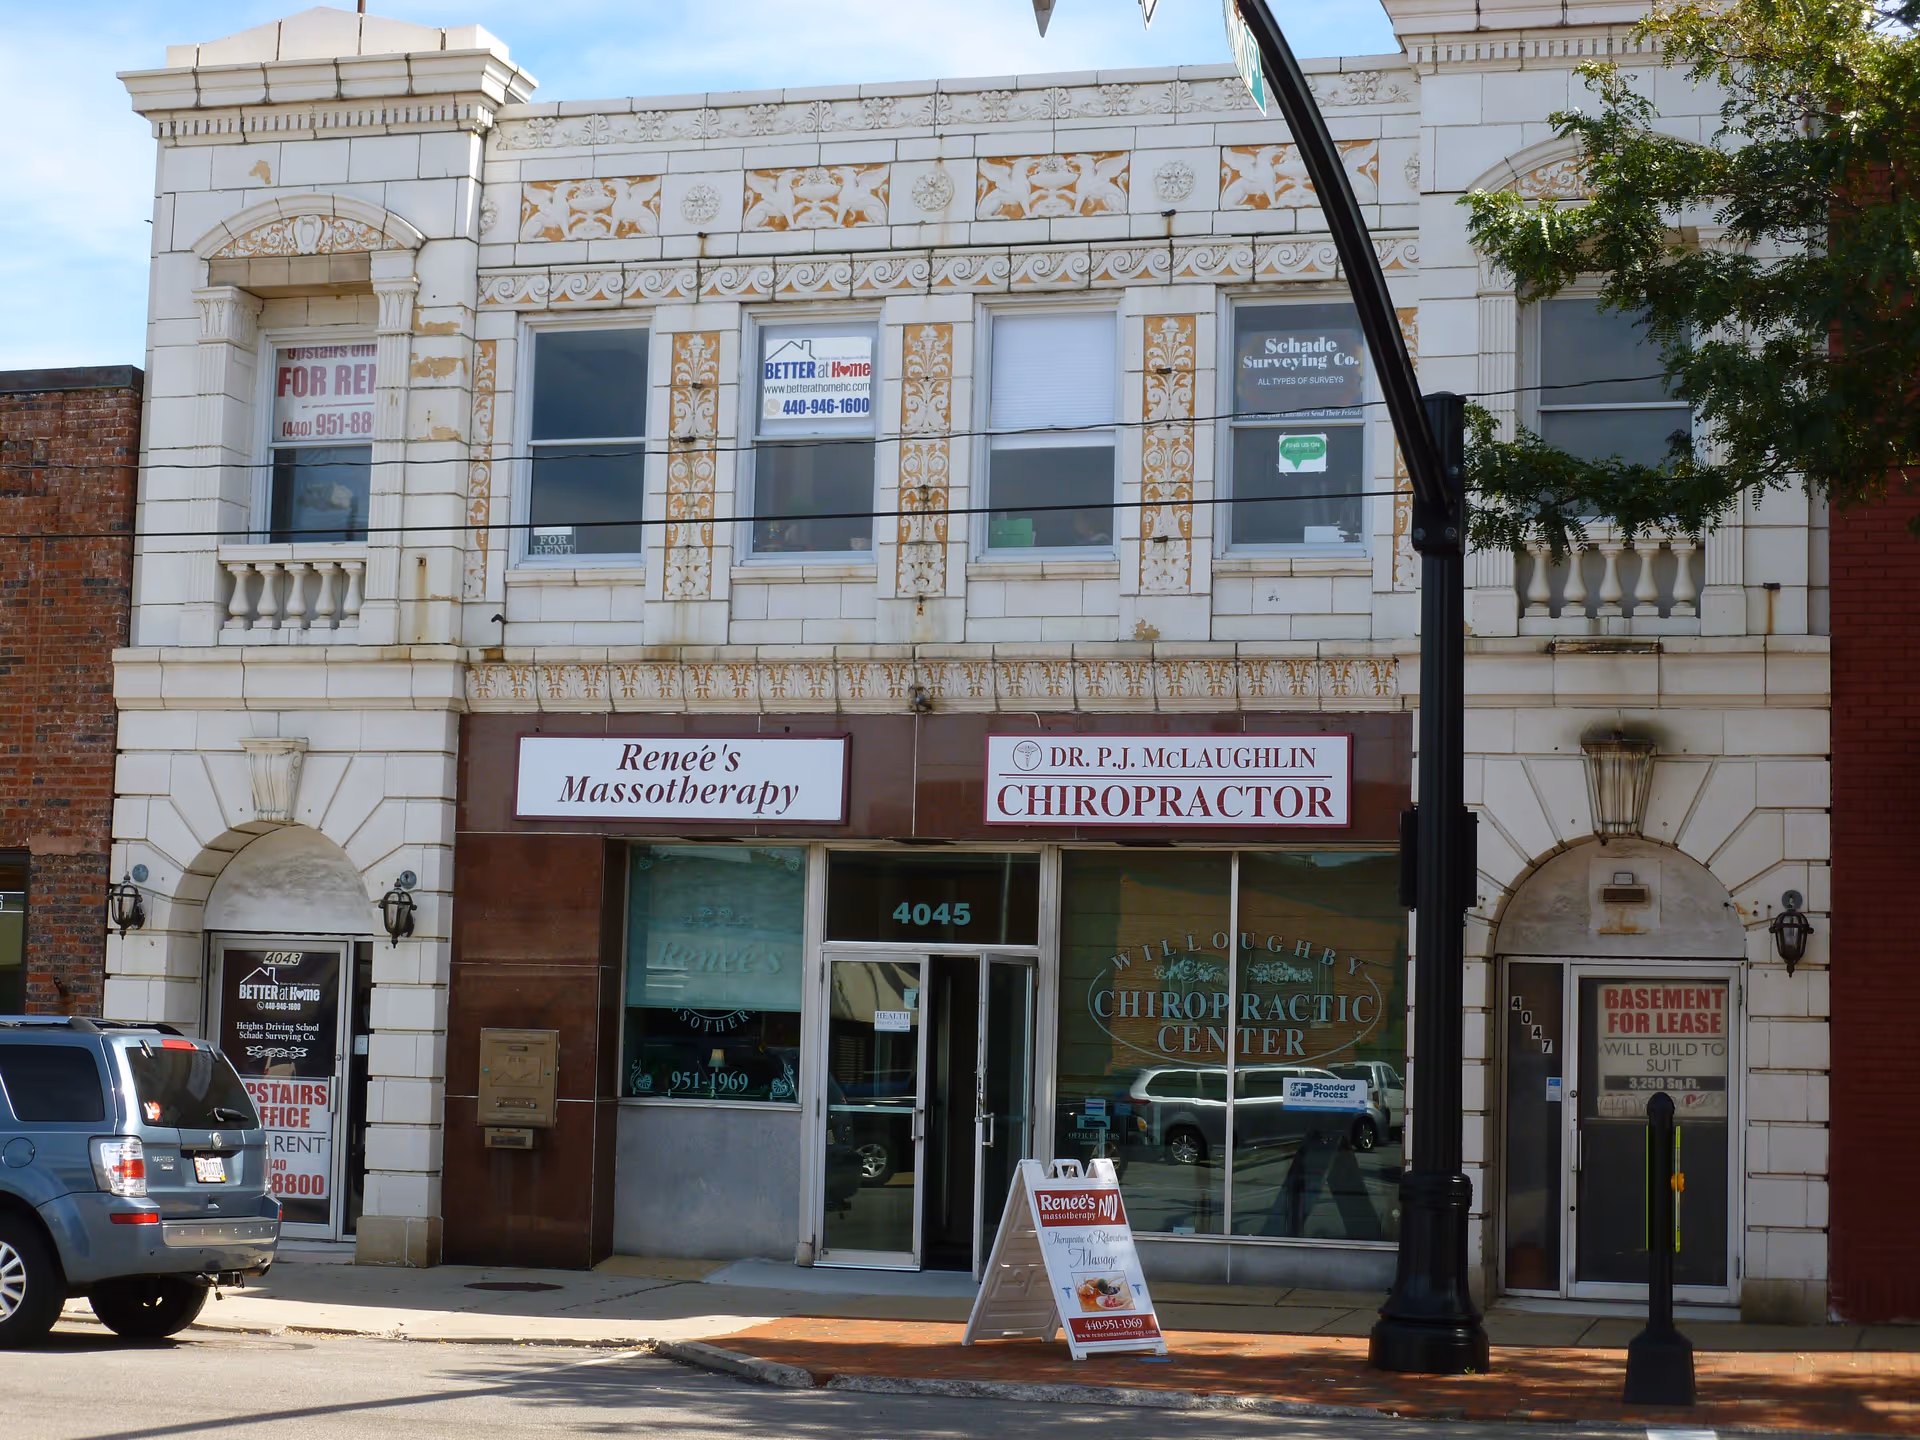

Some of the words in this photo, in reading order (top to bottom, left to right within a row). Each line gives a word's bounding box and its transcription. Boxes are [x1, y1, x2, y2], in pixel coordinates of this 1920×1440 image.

[1265, 336, 1337, 354] Schade
[765, 361, 816, 380] BETTER
[818, 361, 829, 378] at
[1243, 354, 1327, 370] Surveying
[1334, 353, 1360, 366] Co.
[278, 366, 327, 397] FOR
[335, 364, 376, 396] REN
[764, 382, 871, 394] www.betterathomehc.com
[1258, 378, 1271, 386] ALL
[1273, 377, 1296, 386] TYPES
[1298, 377, 1308, 385] OF
[1310, 376, 1344, 385] SURVEYS
[783, 398, 870, 415] 440-946-1600
[282, 421, 312, 437] (440)
[316, 411, 376, 436] 951-88
[540, 535, 567, 545] FOR
[533, 545, 573, 555] RENT
[616, 743, 741, 772] Reneé's
[1049, 746, 1090, 768] DR.
[1098, 747, 1135, 770] P.J.
[557, 775, 799, 815] Massotherapy
[997, 784, 1335, 818] CHIROPRACTOR
[892, 902, 971, 926] 4045
[265, 952, 300, 965] 4043
[1111, 931, 1366, 977] WILLOUGHBY
[239, 984, 278, 1000] BETTER
[279, 986, 288, 1001] at
[1604, 988, 1726, 1010] BASEMENT
[1094, 990, 1374, 1023] CHIROPRACTIC
[674, 1007, 753, 1032] SOTHER
[876, 1012, 909, 1020] HEALTH
[1607, 1012, 1650, 1034] FOR
[1656, 1012, 1721, 1034] LEASE
[236, 1022, 263, 1032] Heights
[265, 1022, 294, 1032] Driving
[295, 1023, 319, 1032] School
[239, 1031, 263, 1040] Schade
[265, 1032, 301, 1042] Surveying
[303, 1032, 316, 1041] Co.
[1157, 1025, 1306, 1056] CENTER
[1603, 1043, 1644, 1056] WILL
[1650, 1043, 1698, 1056] BUILD
[1701, 1043, 1725, 1056] TO
[1646, 1059, 1682, 1073] SUIT
[671, 1070, 749, 1094] 951-1969
[1313, 1083, 1356, 1091] Standard
[1629, 1077, 1664, 1090] 3,250
[246, 1082, 327, 1106] PSTAIRS
[1313, 1091, 1348, 1099] Process
[260, 1106, 310, 1128] FFICE
[274, 1135, 326, 1153] RENT
[272, 1159, 287, 1171] 40
[1040, 1193, 1096, 1211] Reneé's
[1042, 1210, 1096, 1221] massotherapy
[1068, 1246, 1117, 1269] Massage
[1084, 1317, 1143, 1331] 440-951-1969
